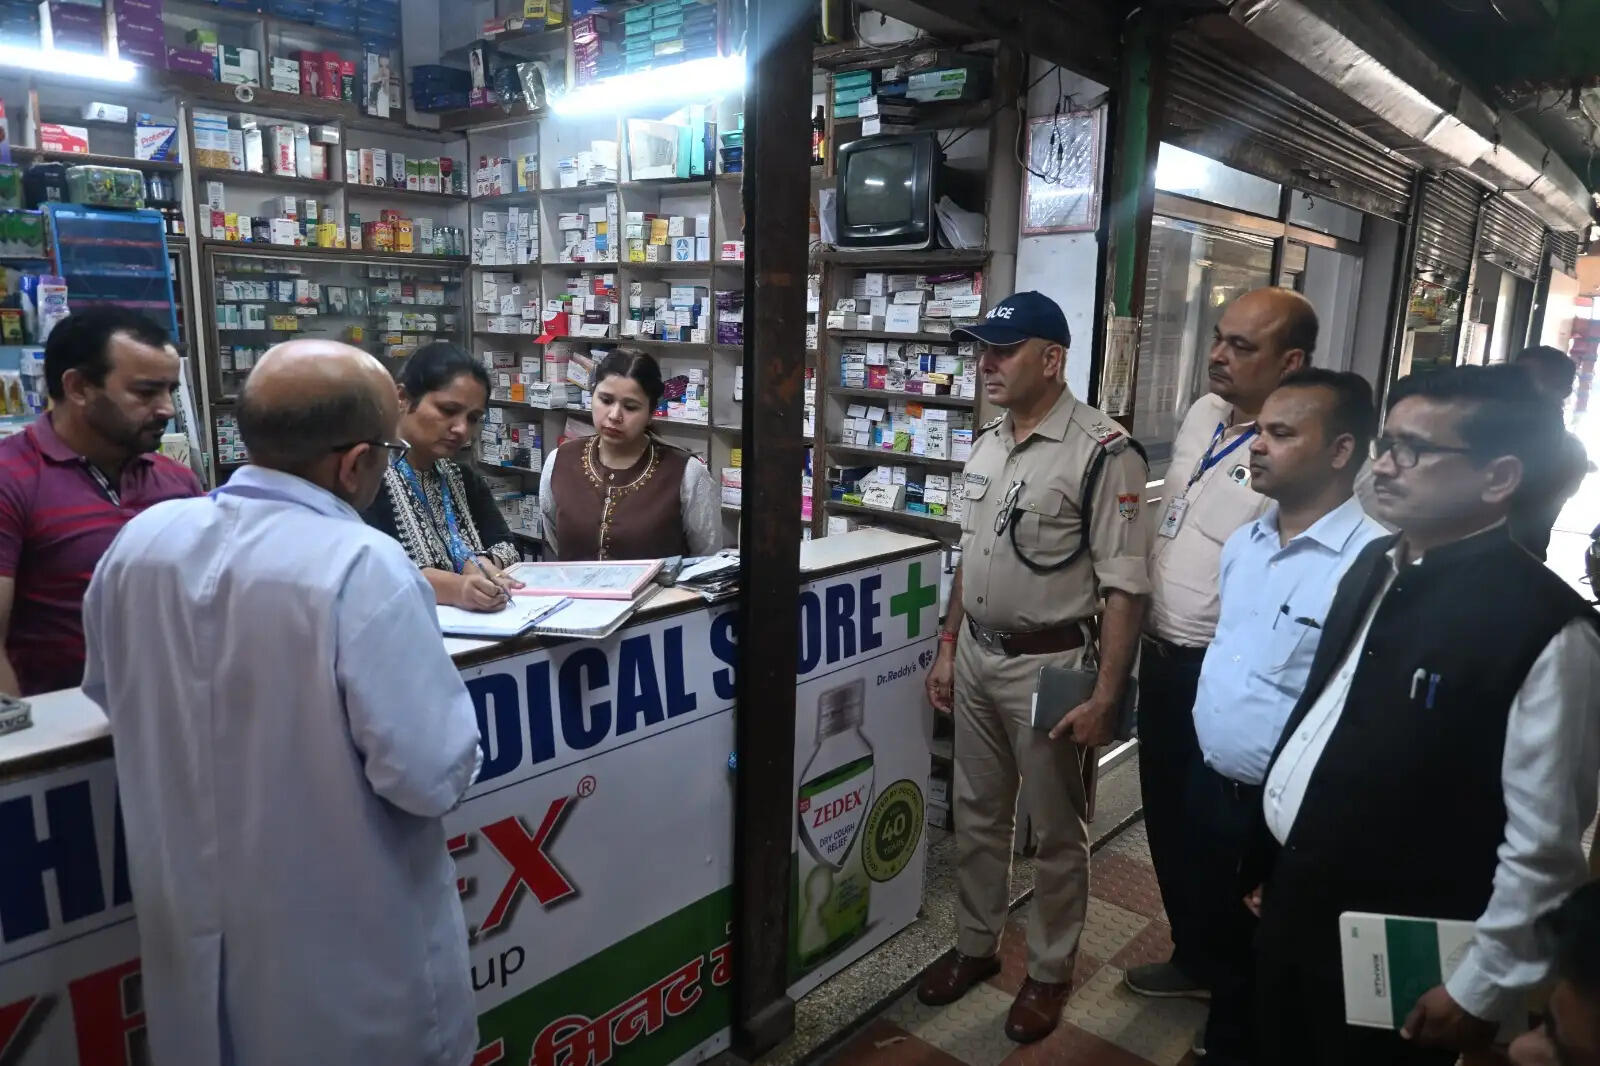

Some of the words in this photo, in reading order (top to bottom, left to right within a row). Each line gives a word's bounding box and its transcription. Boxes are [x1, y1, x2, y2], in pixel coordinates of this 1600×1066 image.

[465, 625, 698, 784] DICAL
[812, 788, 862, 829] ZEDEX
[882, 812, 906, 841] 40
